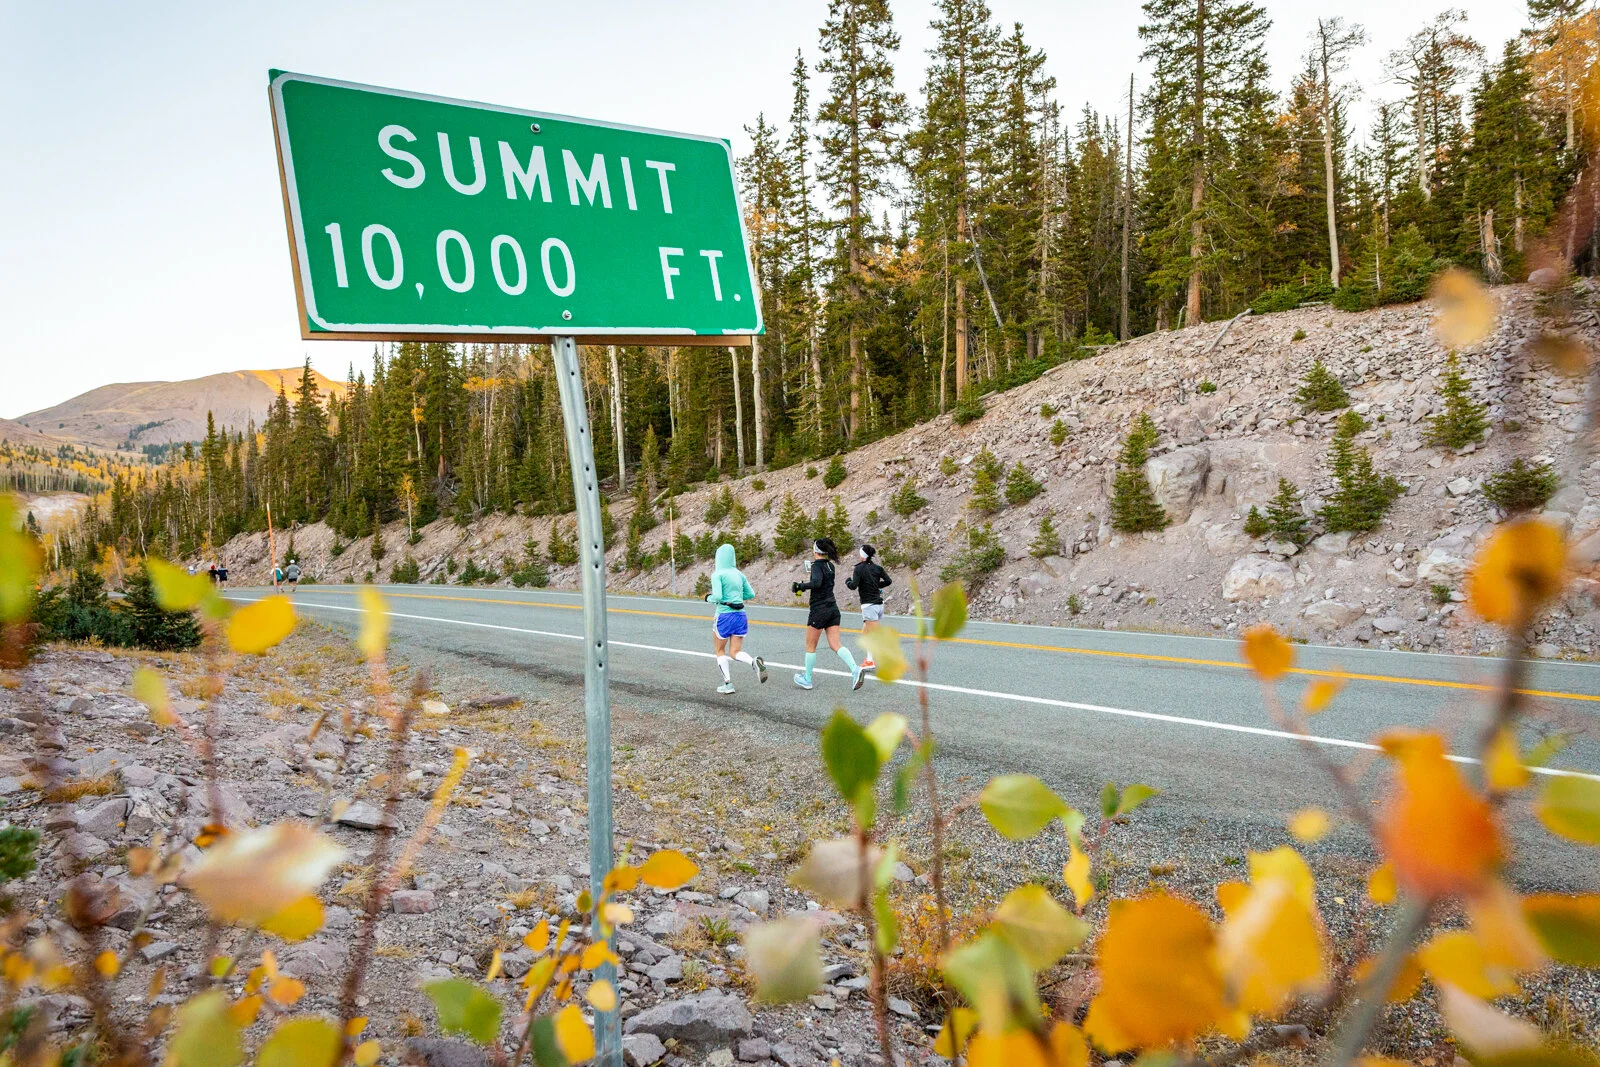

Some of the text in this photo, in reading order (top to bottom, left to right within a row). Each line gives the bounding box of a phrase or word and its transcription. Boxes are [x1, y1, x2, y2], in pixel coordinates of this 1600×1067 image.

[378, 124, 676, 214] SUMMIT
[324, 222, 742, 302] 10,000 FT.
